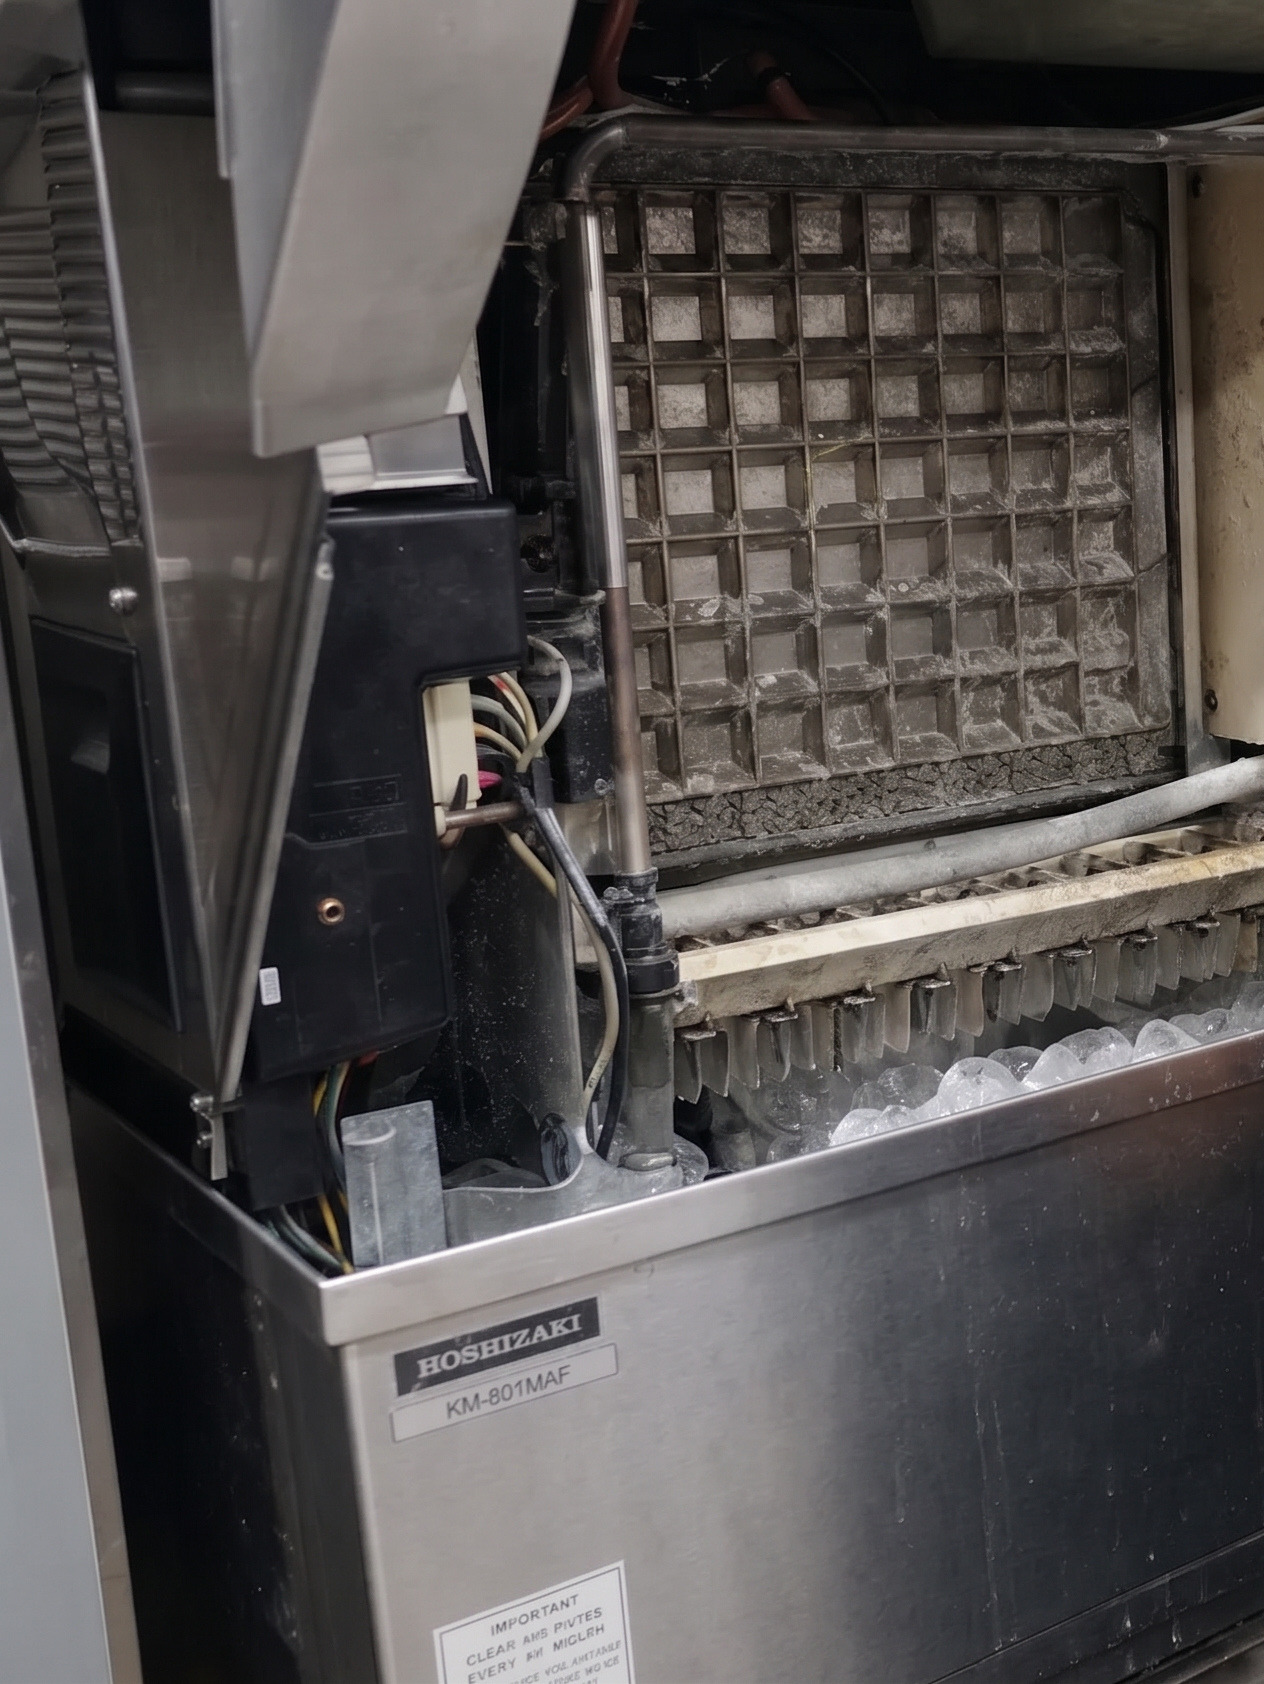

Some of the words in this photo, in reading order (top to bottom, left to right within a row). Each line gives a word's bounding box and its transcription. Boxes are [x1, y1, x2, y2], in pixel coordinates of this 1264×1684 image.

[417, 1313, 582, 1379] HOSHIZAKI
[446, 1364, 571, 1419] KM-801MAF
[490, 1594, 579, 1637] IMPORTANT
[466, 1639, 516, 1667] CLEAR
[467, 1657, 517, 1684] EVERY
